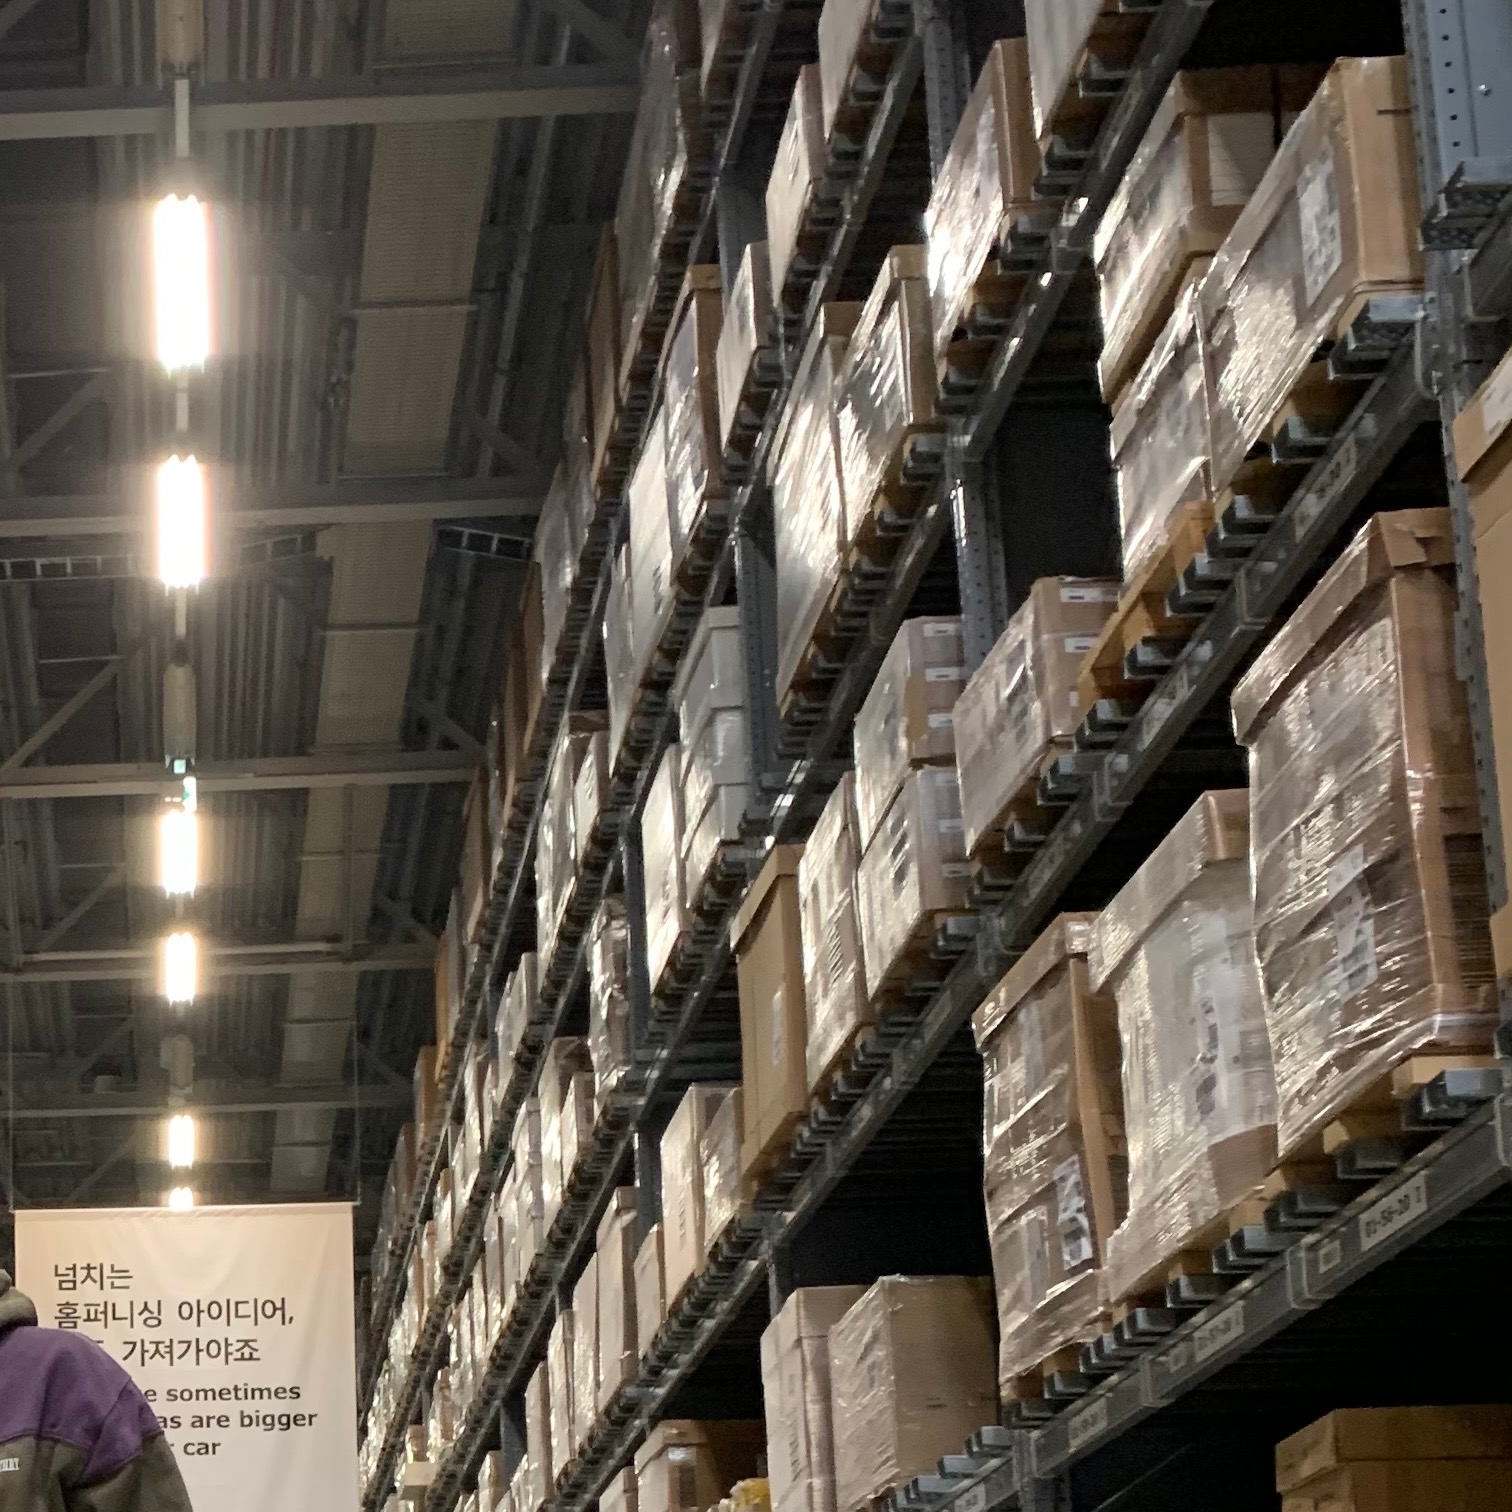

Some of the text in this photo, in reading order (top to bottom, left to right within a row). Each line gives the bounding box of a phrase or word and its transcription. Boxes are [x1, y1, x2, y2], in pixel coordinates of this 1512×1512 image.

[54, 1262, 134, 1291] 넘치는
[54, 1297, 294, 1329] 홈퍼니싱 아이디어,
[121, 1337, 261, 1367] 가져가야죠
[166, 1382, 301, 1402] sometimes
[191, 1412, 230, 1428] are
[240, 1409, 318, 1431] bigger
[183, 1440, 221, 1456] car
